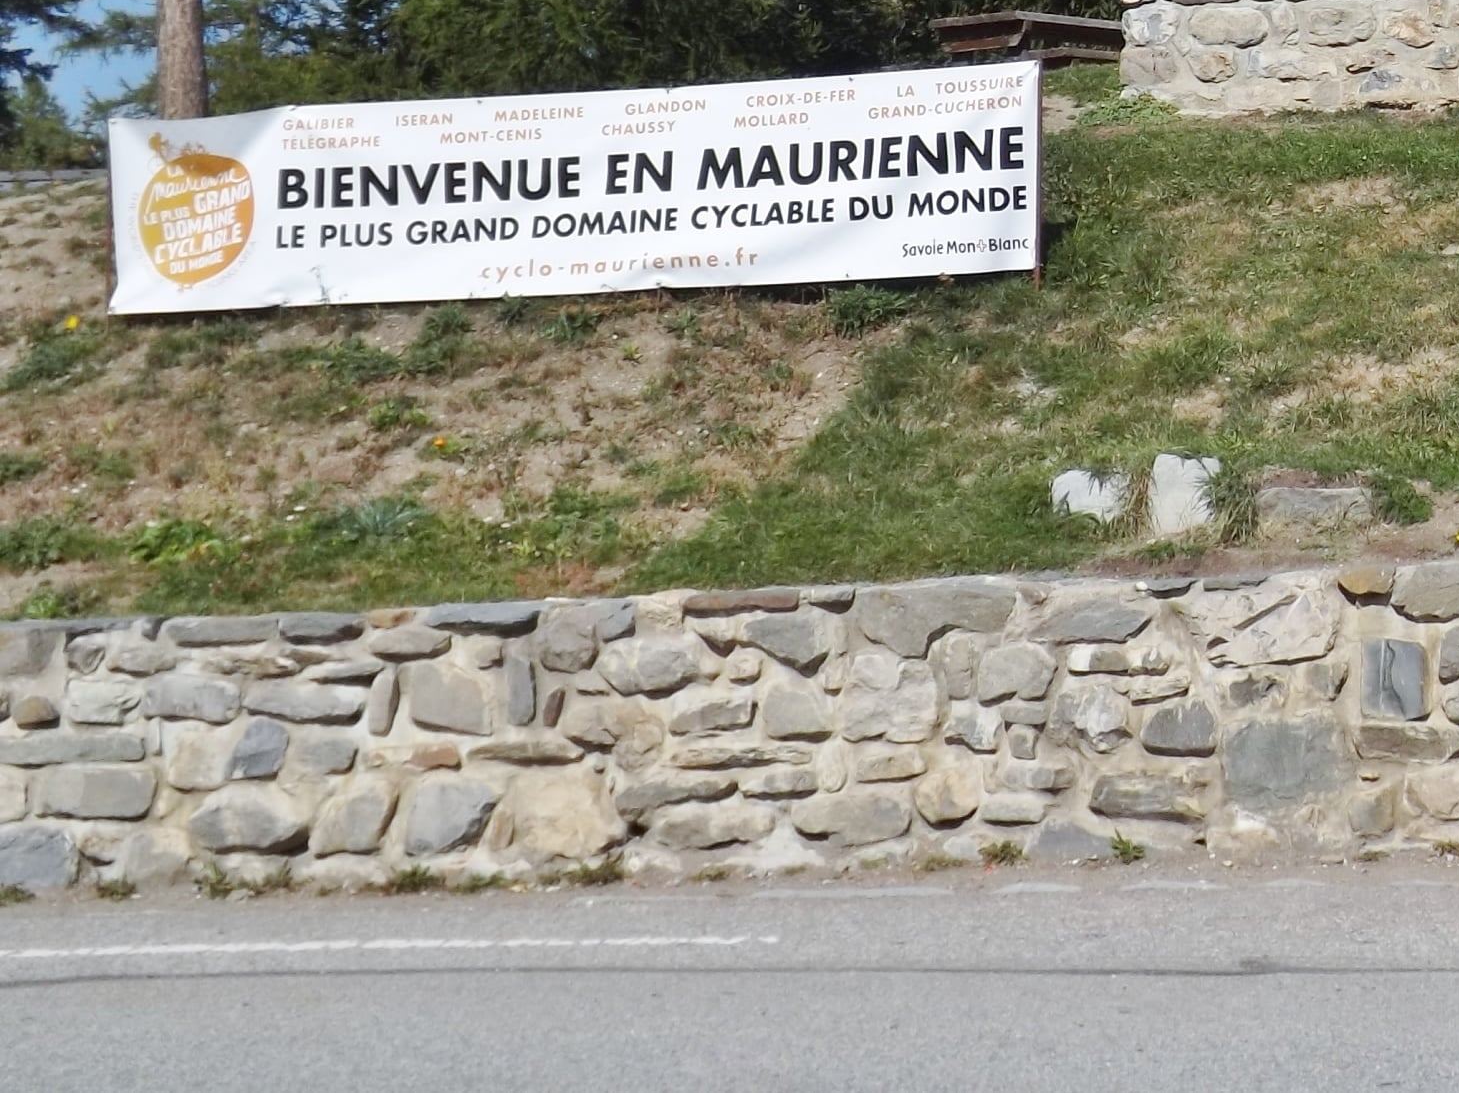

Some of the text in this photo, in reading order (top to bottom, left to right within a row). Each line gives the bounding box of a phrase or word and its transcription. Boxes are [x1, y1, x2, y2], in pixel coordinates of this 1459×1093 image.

[282, 75, 1024, 131] GALIBIER ISERAN MADELEINE GLANDON CROIX-DE-FER LA TOUSSUIRE
[440, 128, 542, 145] MONT-CENIS
[601, 120, 676, 137] CHAUSSY
[733, 112, 809, 129] MOLLARD
[868, 96, 1022, 120] GRAND-CUCHERON
[166, 164, 184, 178] LA
[277, 126, 1024, 209] BIENVENUE EN MAURIENNE
[144, 180, 251, 225] LE PLUS GRAND
[163, 206, 237, 240] DOMAINE
[276, 185, 1027, 249] LE PLUS GRAND DOMAINE CYCLABLE DU MONDE
[154, 223, 243, 265] CYCLABLE
[481, 247, 758, 283] cyclo-maurienne.fr
[902, 238, 944, 258] Savoie
